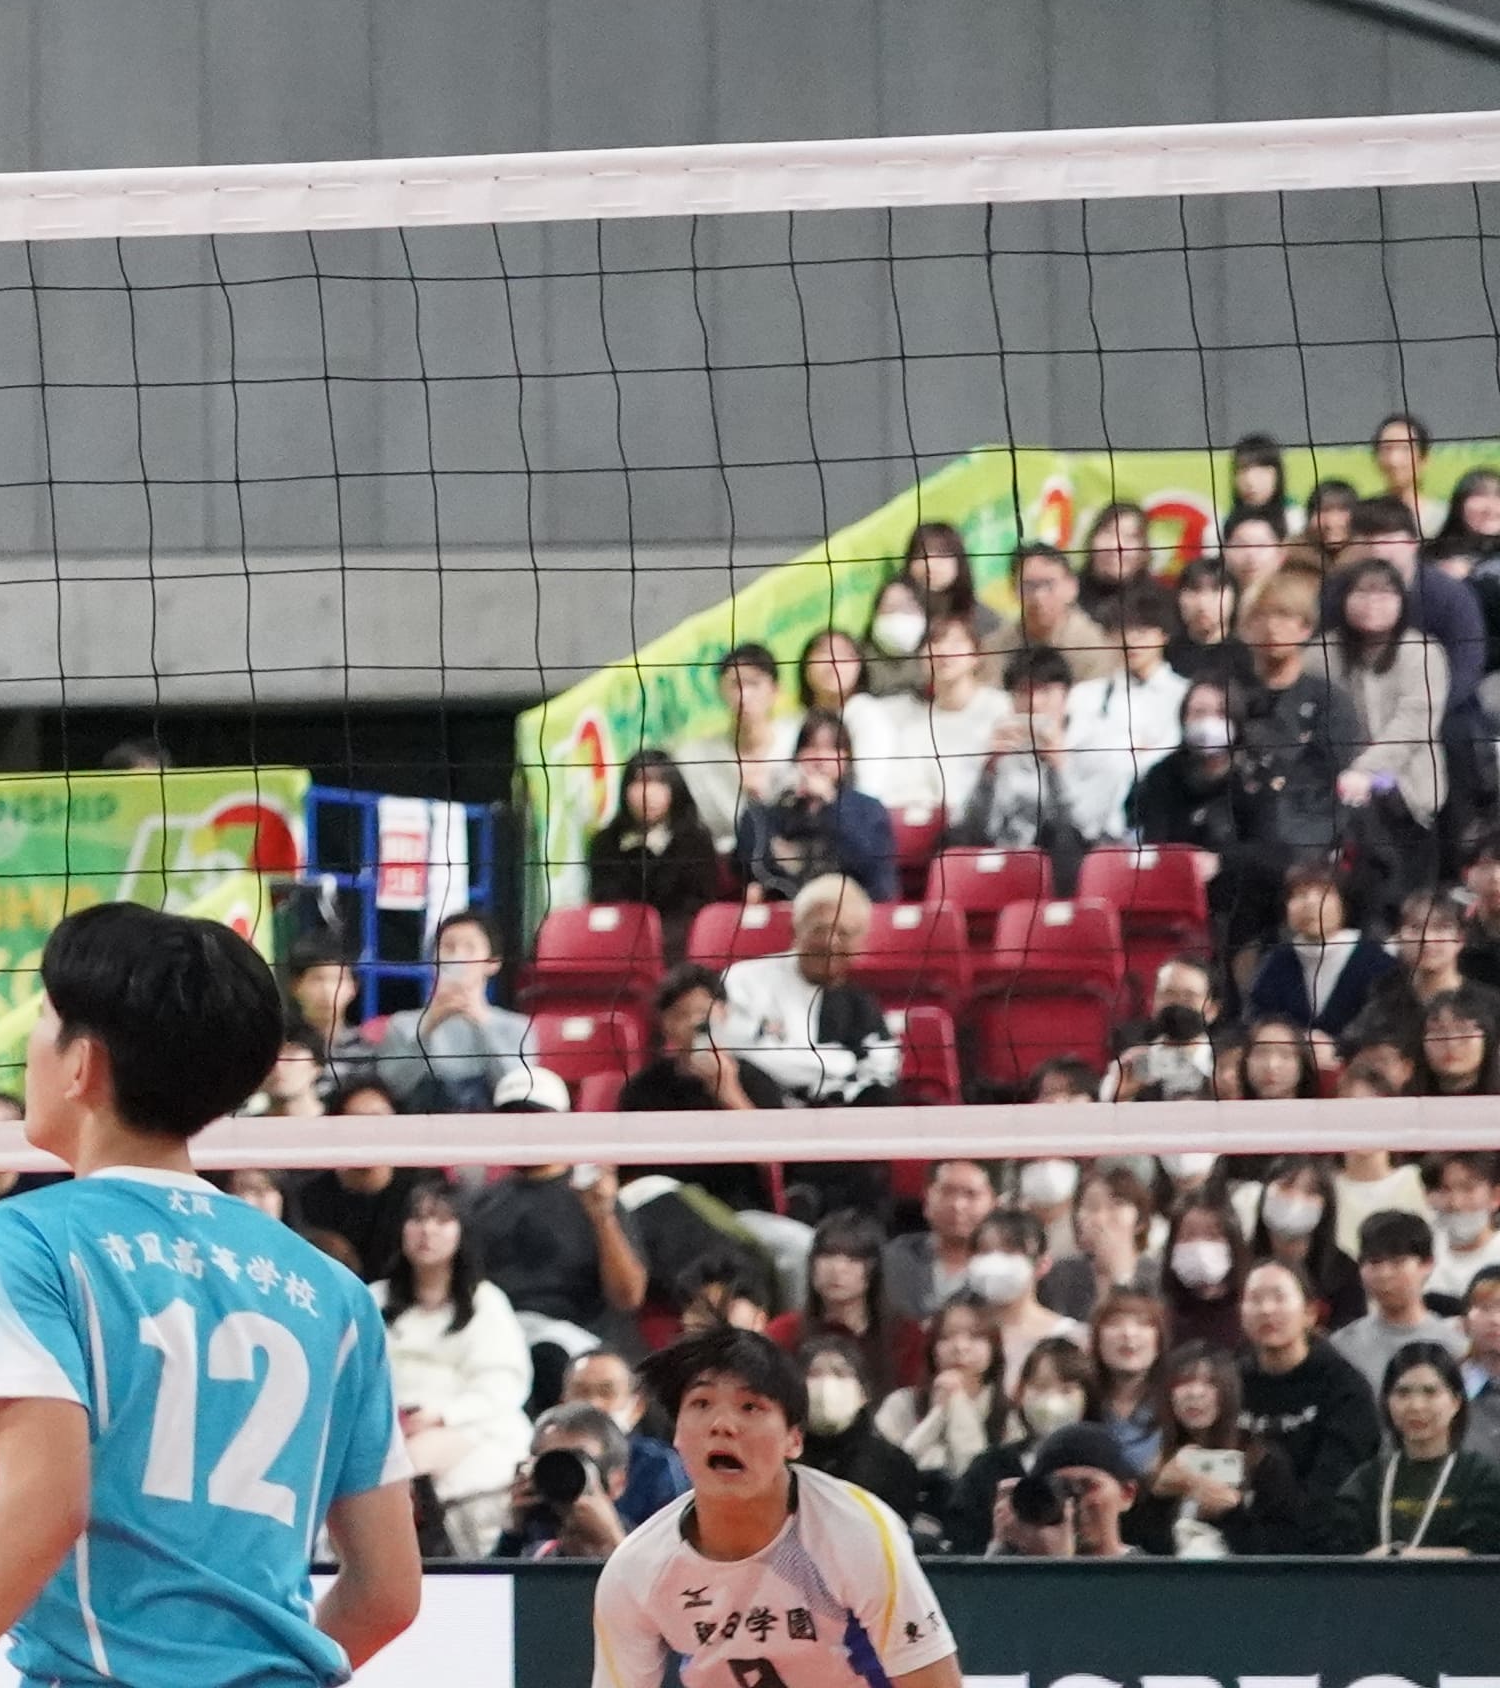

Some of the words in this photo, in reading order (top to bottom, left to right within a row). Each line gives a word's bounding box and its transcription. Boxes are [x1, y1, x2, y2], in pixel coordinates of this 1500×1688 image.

[101, 1230, 319, 1319] 清風高等学校
[139, 1296, 311, 1529] 12
